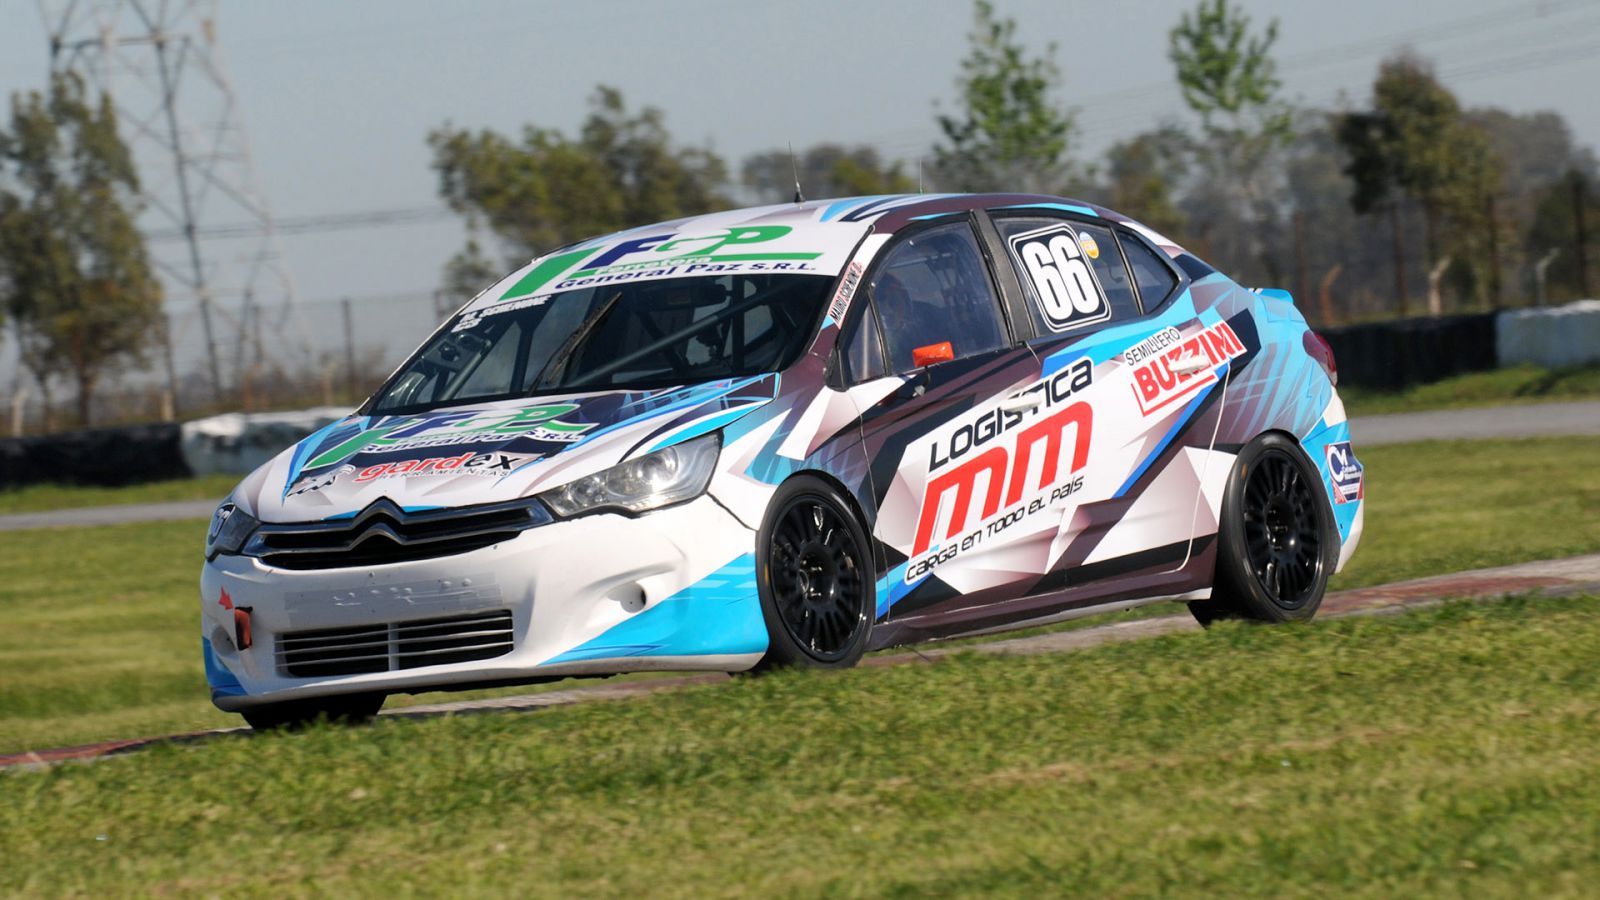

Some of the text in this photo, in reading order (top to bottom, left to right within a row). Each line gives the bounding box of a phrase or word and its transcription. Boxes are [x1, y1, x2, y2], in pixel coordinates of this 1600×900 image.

[554, 262, 817, 289] General Paz S.R.L.
[1021, 235, 1100, 320] 66
[1125, 328, 1181, 366] SEMILLERO
[353, 452, 521, 483] gardex
